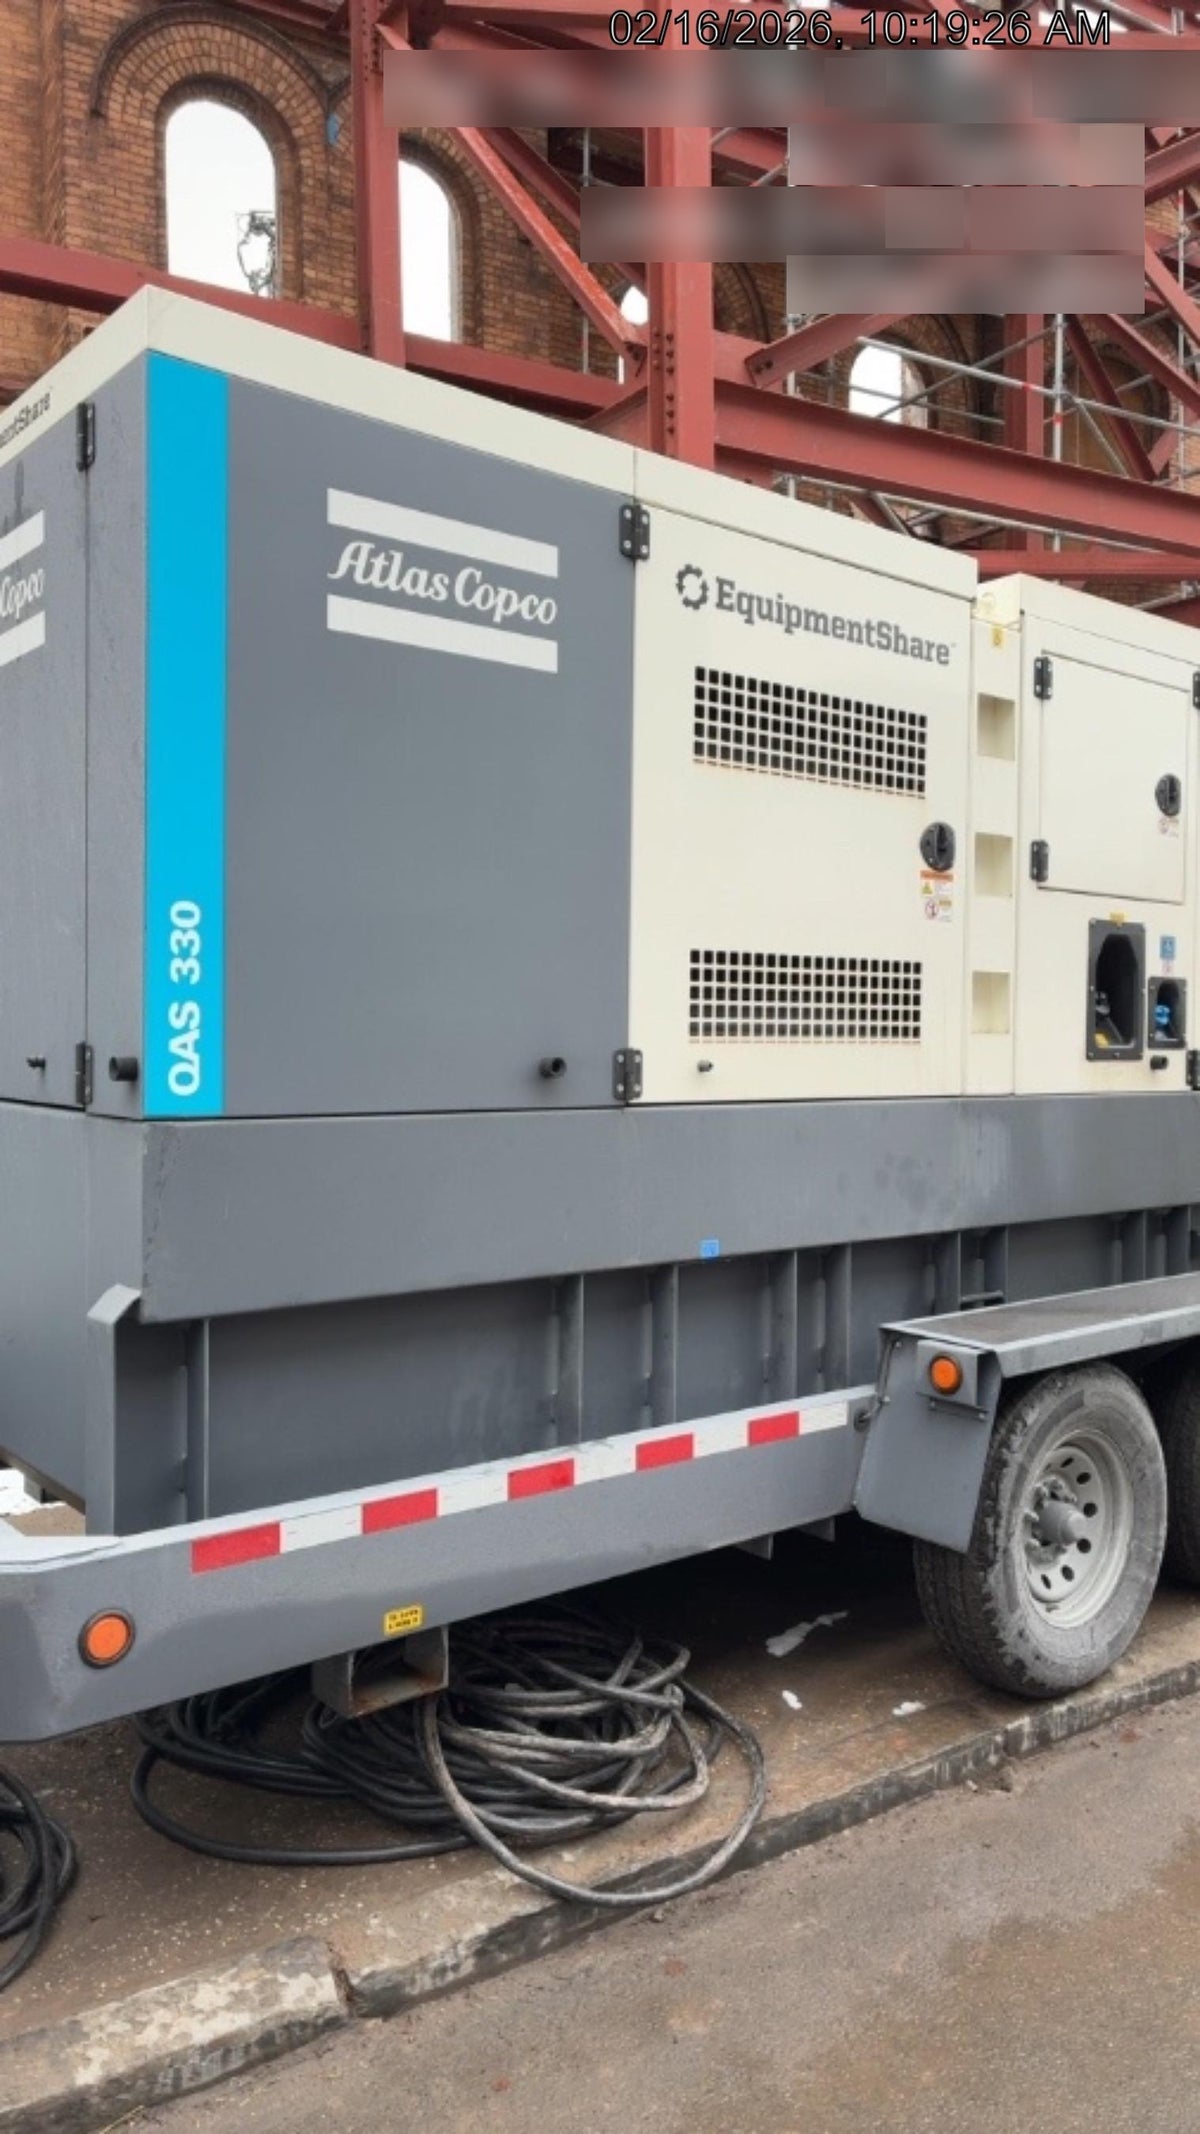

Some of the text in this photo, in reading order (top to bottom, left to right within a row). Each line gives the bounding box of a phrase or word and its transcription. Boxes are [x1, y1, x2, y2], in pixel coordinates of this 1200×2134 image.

[327, 541, 557, 624] Atlas Copco
[715, 576, 950, 665] EquipmentShare
[168, 900, 201, 1096] QAS 330
